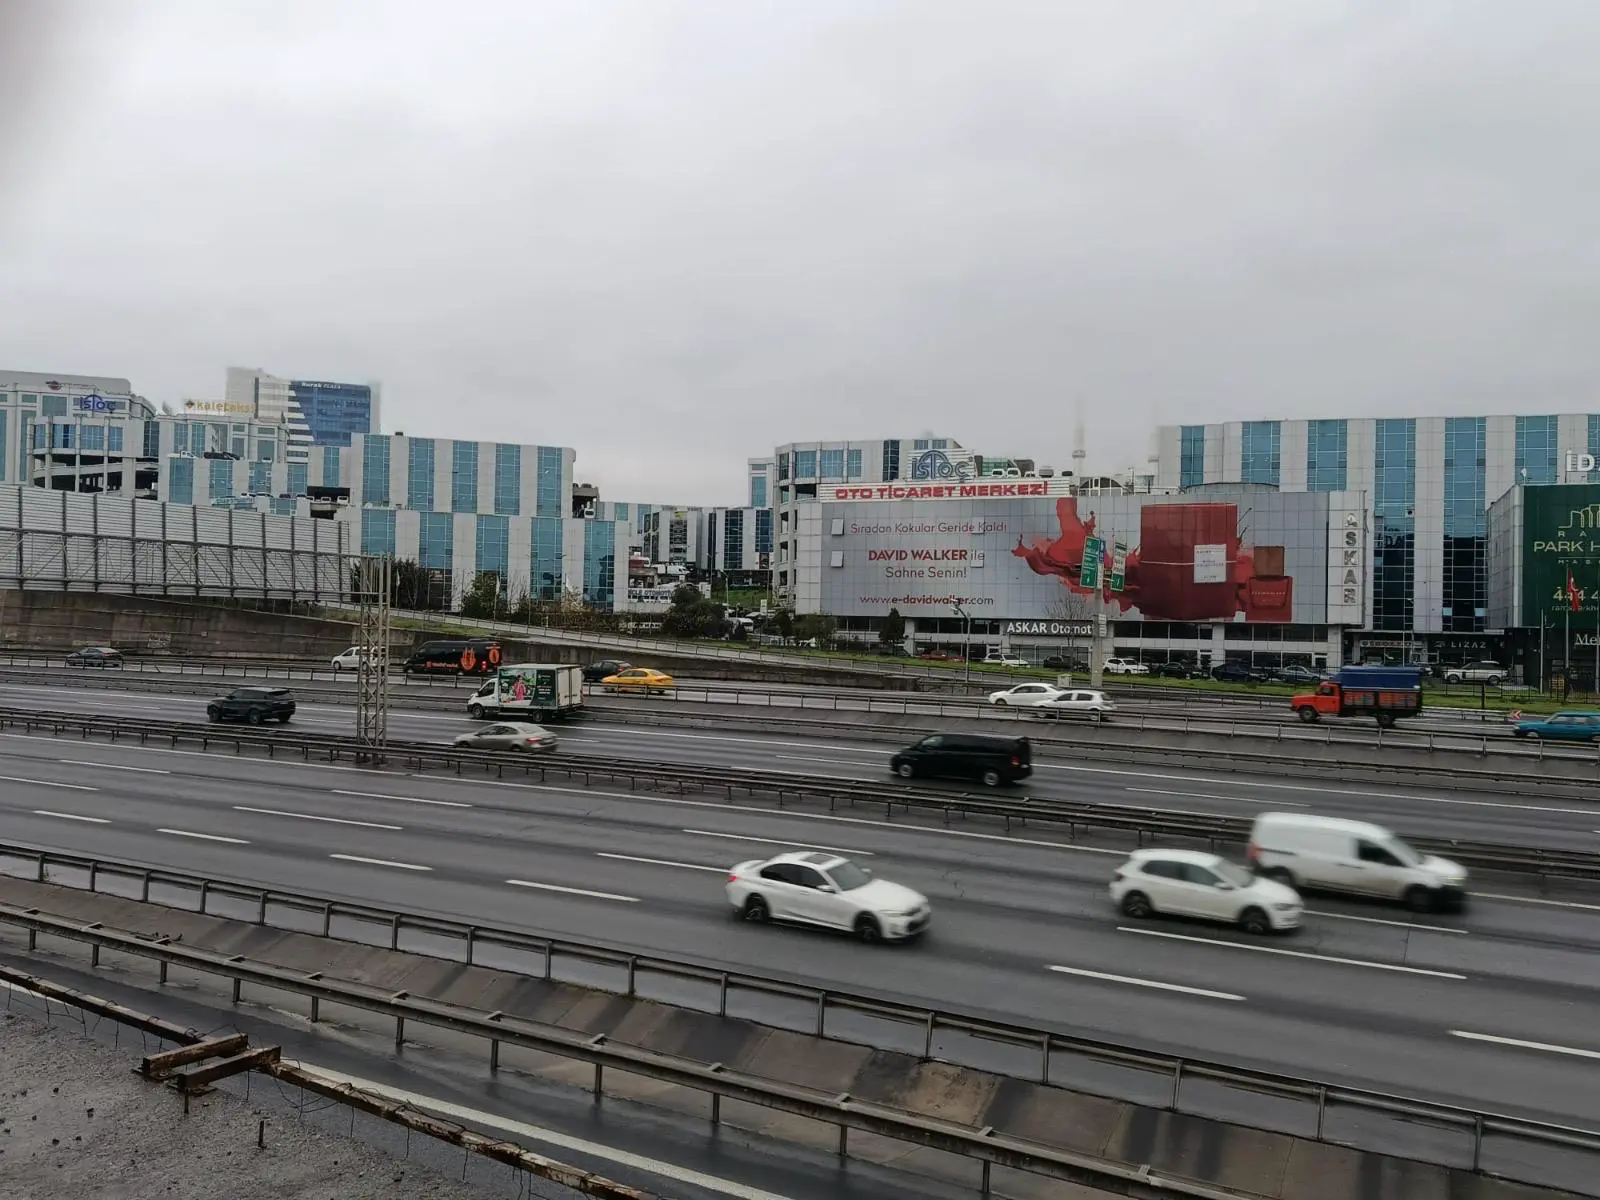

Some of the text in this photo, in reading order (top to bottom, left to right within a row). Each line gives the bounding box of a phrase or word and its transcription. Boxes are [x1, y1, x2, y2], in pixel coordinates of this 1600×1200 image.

[1566, 450, 1600, 472] İD
[835, 481, 1048, 500] OTO TİCARET MERKEZİ
[850, 521, 1007, 534] Sıradan Kokular Geride Kaldı
[1533, 541, 1584, 552] PARK
[868, 549, 985, 561] DAVID WALKER ile
[1344, 512, 1358, 604] ASKAR
[885, 566, 967, 578] Sahne Senin!
[1007, 622, 1048, 633] ASKAR
